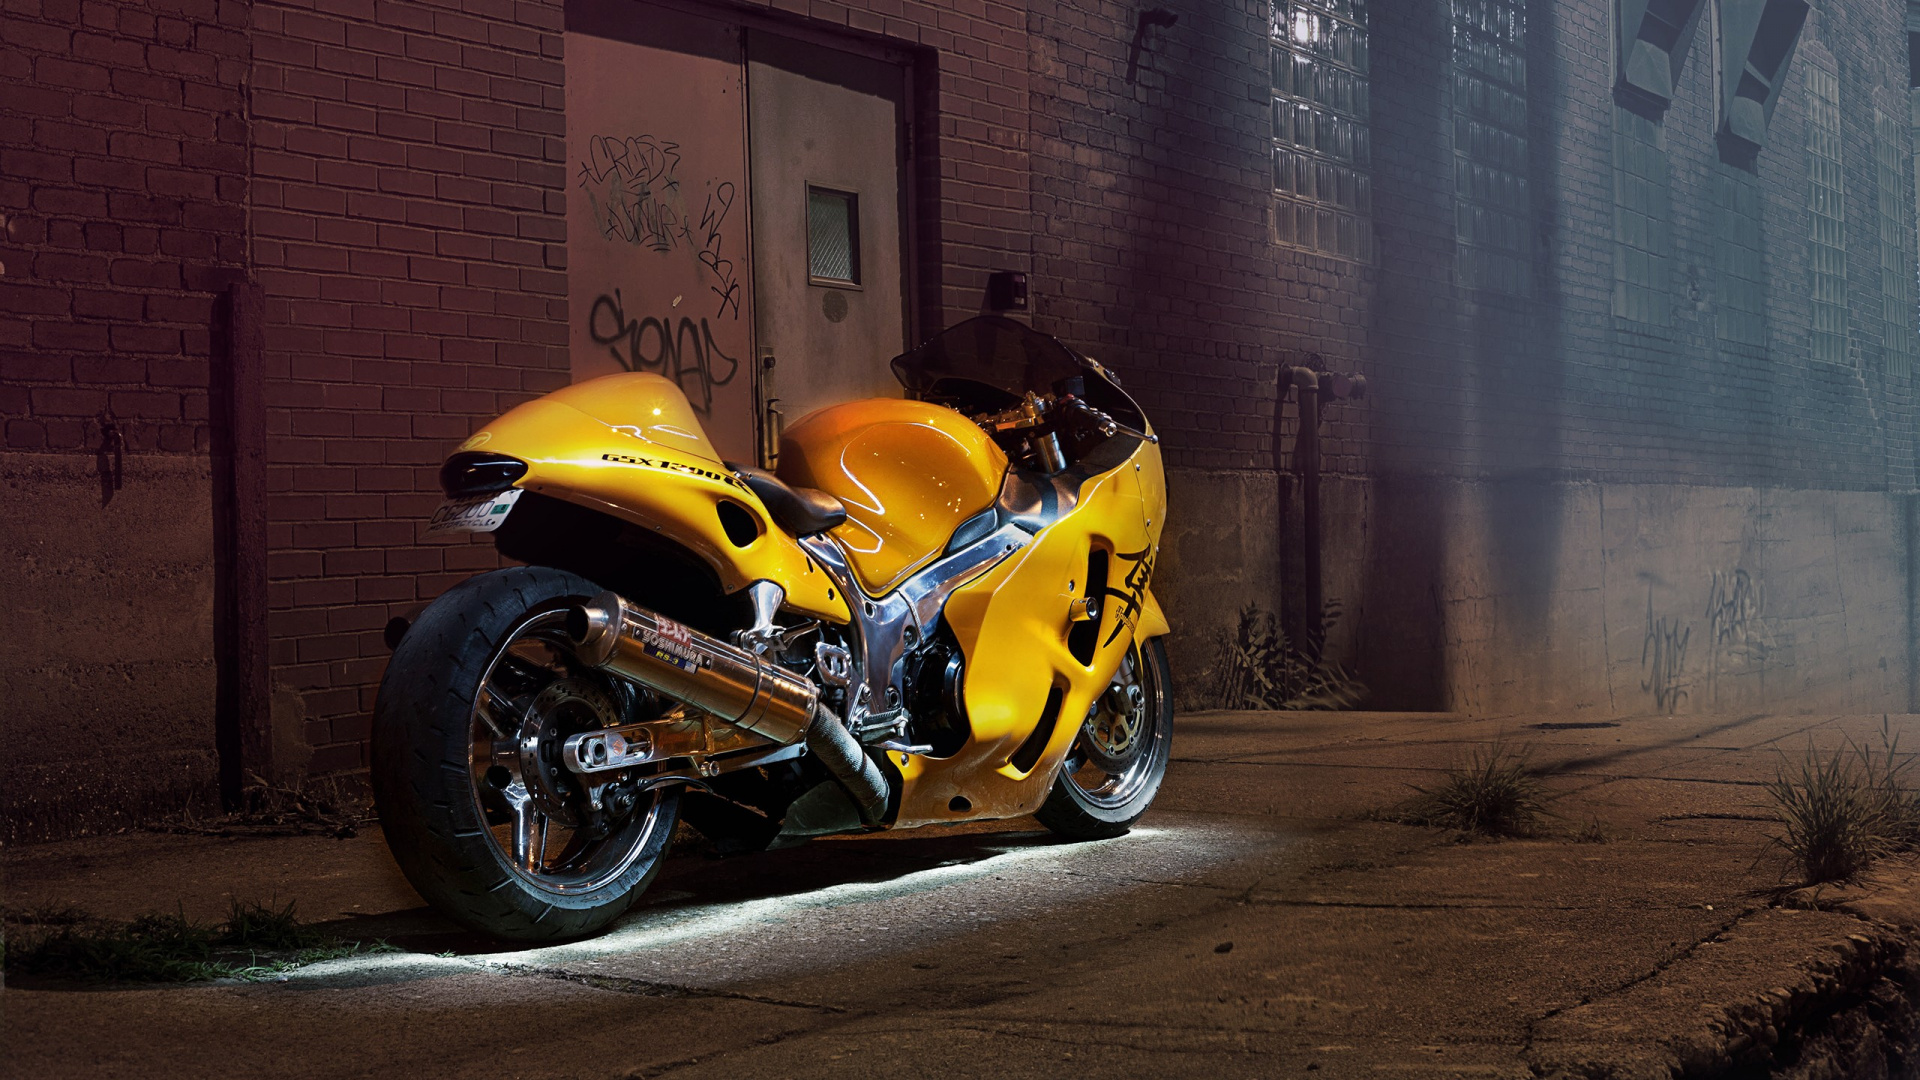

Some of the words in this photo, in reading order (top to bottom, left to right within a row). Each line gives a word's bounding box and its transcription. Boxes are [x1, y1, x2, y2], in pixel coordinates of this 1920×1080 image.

[601, 454, 652, 466] GSX
[428, 518, 493, 531] MOTORCYCLE
[642, 629, 703, 666] YOSHIMURA
[655, 651, 679, 665] RS-3
